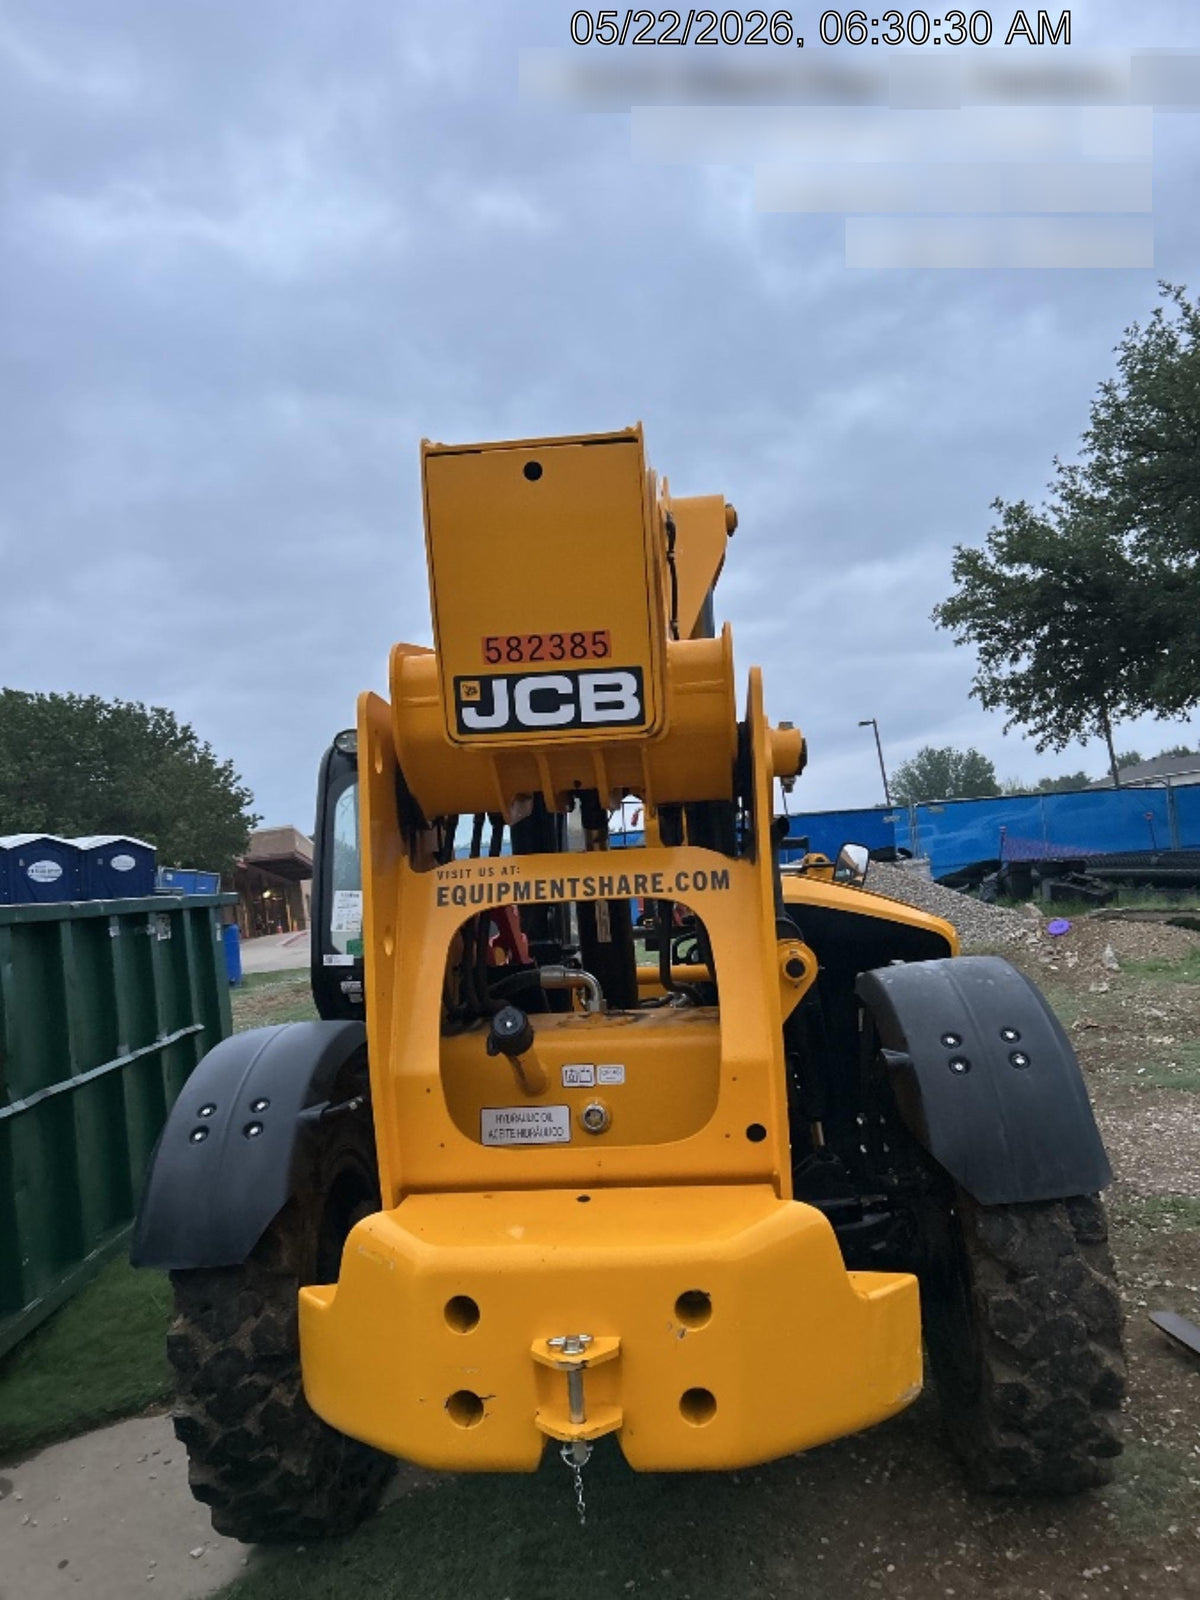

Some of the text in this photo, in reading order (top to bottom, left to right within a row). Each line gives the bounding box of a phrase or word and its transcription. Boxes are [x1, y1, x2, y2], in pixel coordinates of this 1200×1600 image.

[485, 631, 609, 664] 582385
[461, 671, 641, 729] JCB
[436, 865, 520, 881] VISIT US AT:
[436, 868, 730, 907] EQUIPMENTSHARE.COM
